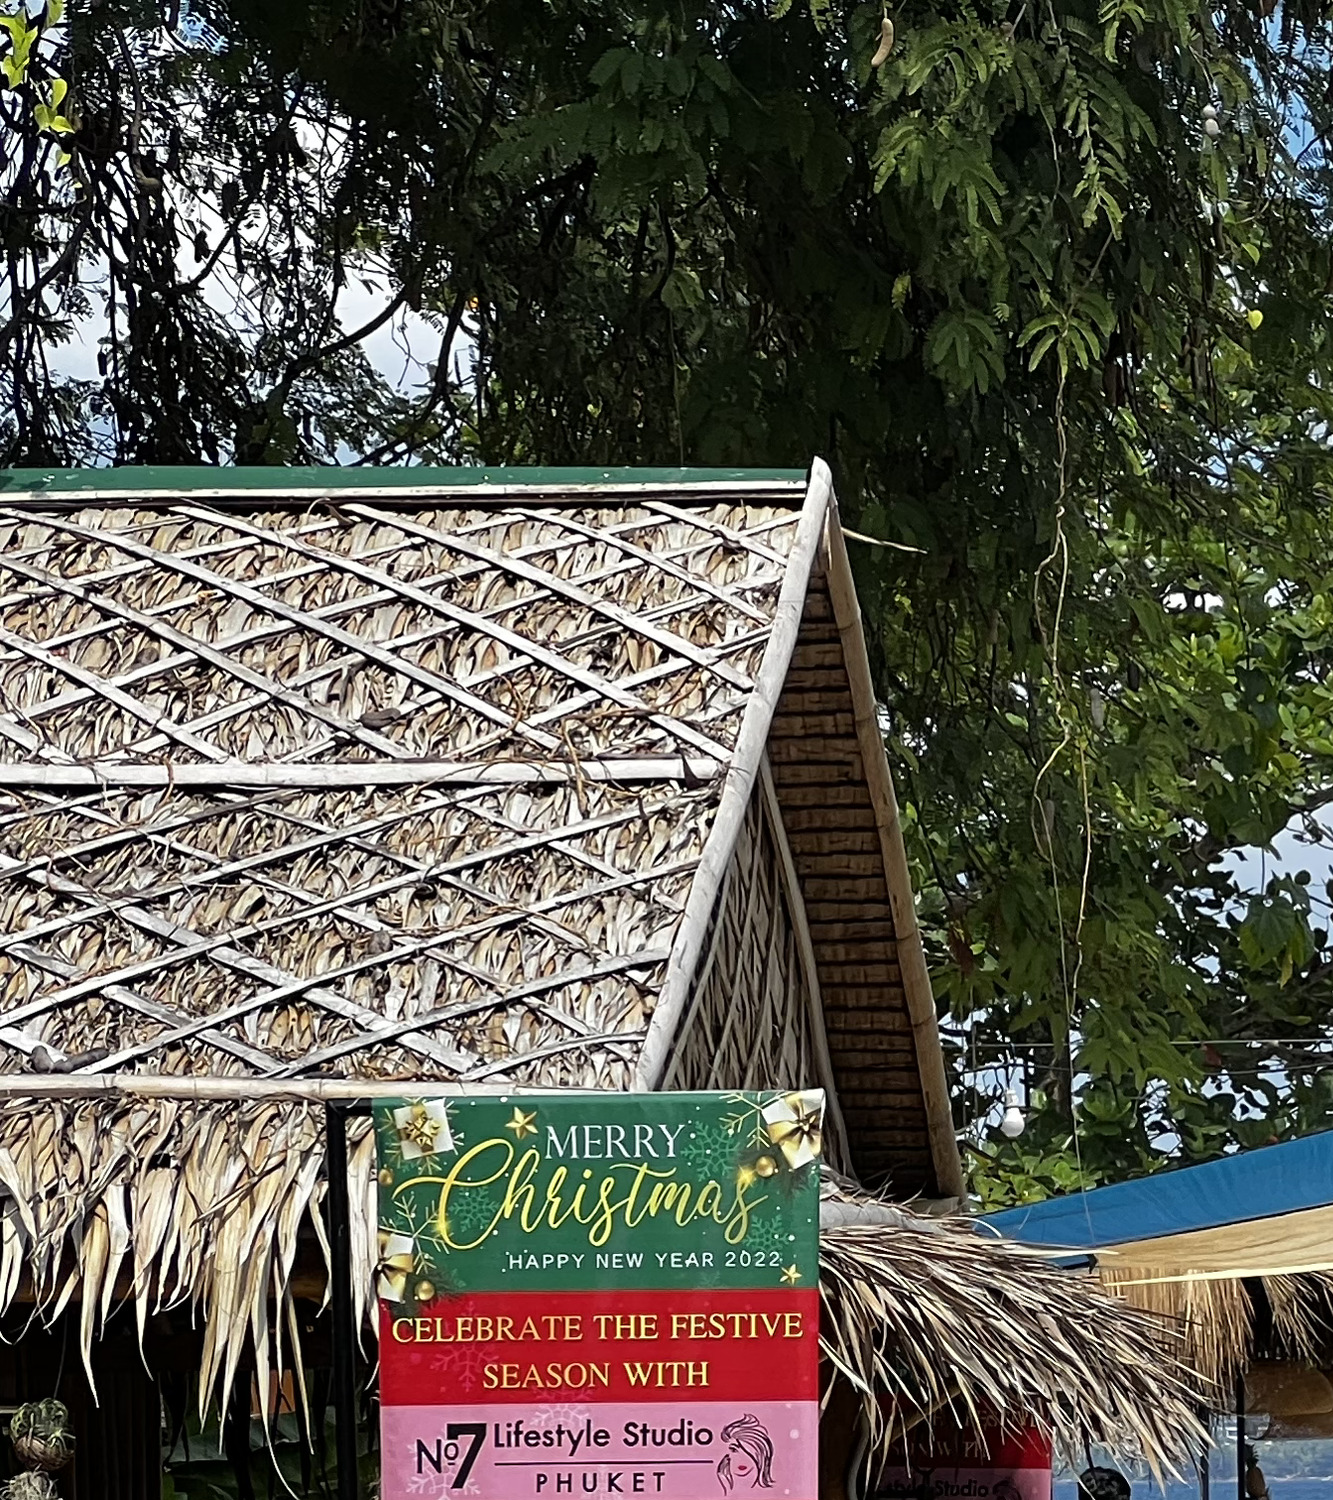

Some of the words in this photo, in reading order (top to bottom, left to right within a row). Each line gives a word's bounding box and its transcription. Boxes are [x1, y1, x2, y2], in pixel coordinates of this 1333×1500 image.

[545, 1124, 685, 1159] MERRY
[393, 1138, 768, 1250] Christmas
[508, 1254, 585, 1270] HAPPY
[596, 1253, 643, 1269] NEW
[656, 1252, 713, 1268] YEAR
[725, 1252, 780, 1268] 2022
[392, 1315, 583, 1343] CELEBRATE
[594, 1314, 657, 1340] THE
[671, 1313, 803, 1339] FESTIVE
[483, 1363, 610, 1390] SEASON
[624, 1361, 709, 1387] WITH
[493, 1421, 610, 1456] Lifestyle
[623, 1419, 713, 1448] Studio
[536, 1471, 665, 1494] PHUKET
[935, 1479, 989, 1498] Studio
